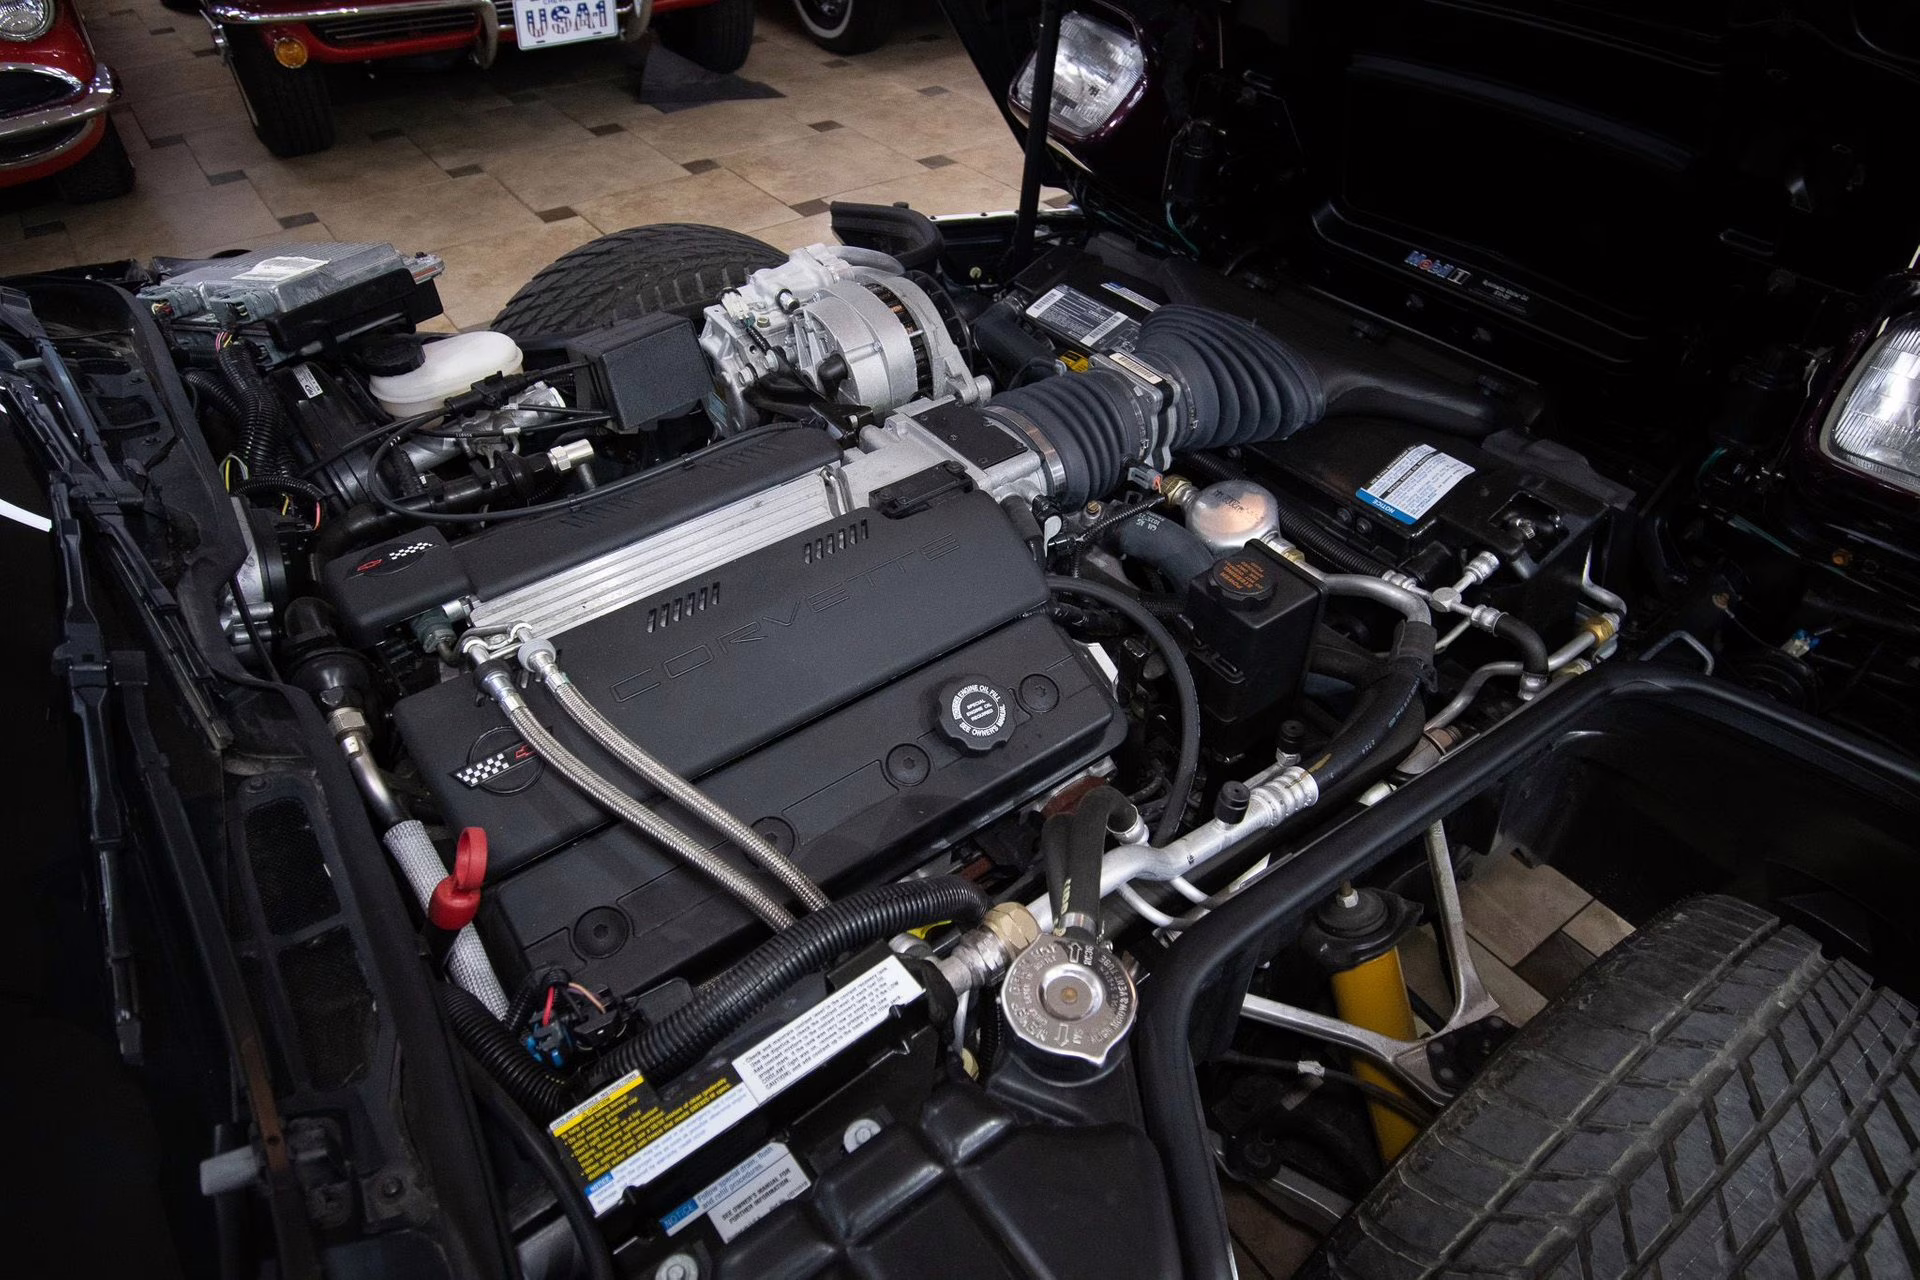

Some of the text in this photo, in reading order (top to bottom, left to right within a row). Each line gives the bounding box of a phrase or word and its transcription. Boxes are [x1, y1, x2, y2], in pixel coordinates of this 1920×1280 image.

[1404, 251, 1454, 278] Mobil
[1372, 499, 1395, 514] NOTICE
[611, 533, 959, 703] CORVETTE
[958, 685, 1001, 702] ENGINE OIL FILL
[960, 722, 970, 733] SEE
[1100, 954, 1118, 976] TUBE
[701, 1197, 715, 1209] and
[662, 1202, 696, 1228] NOTICE
[721, 1210, 733, 1220] SEE
